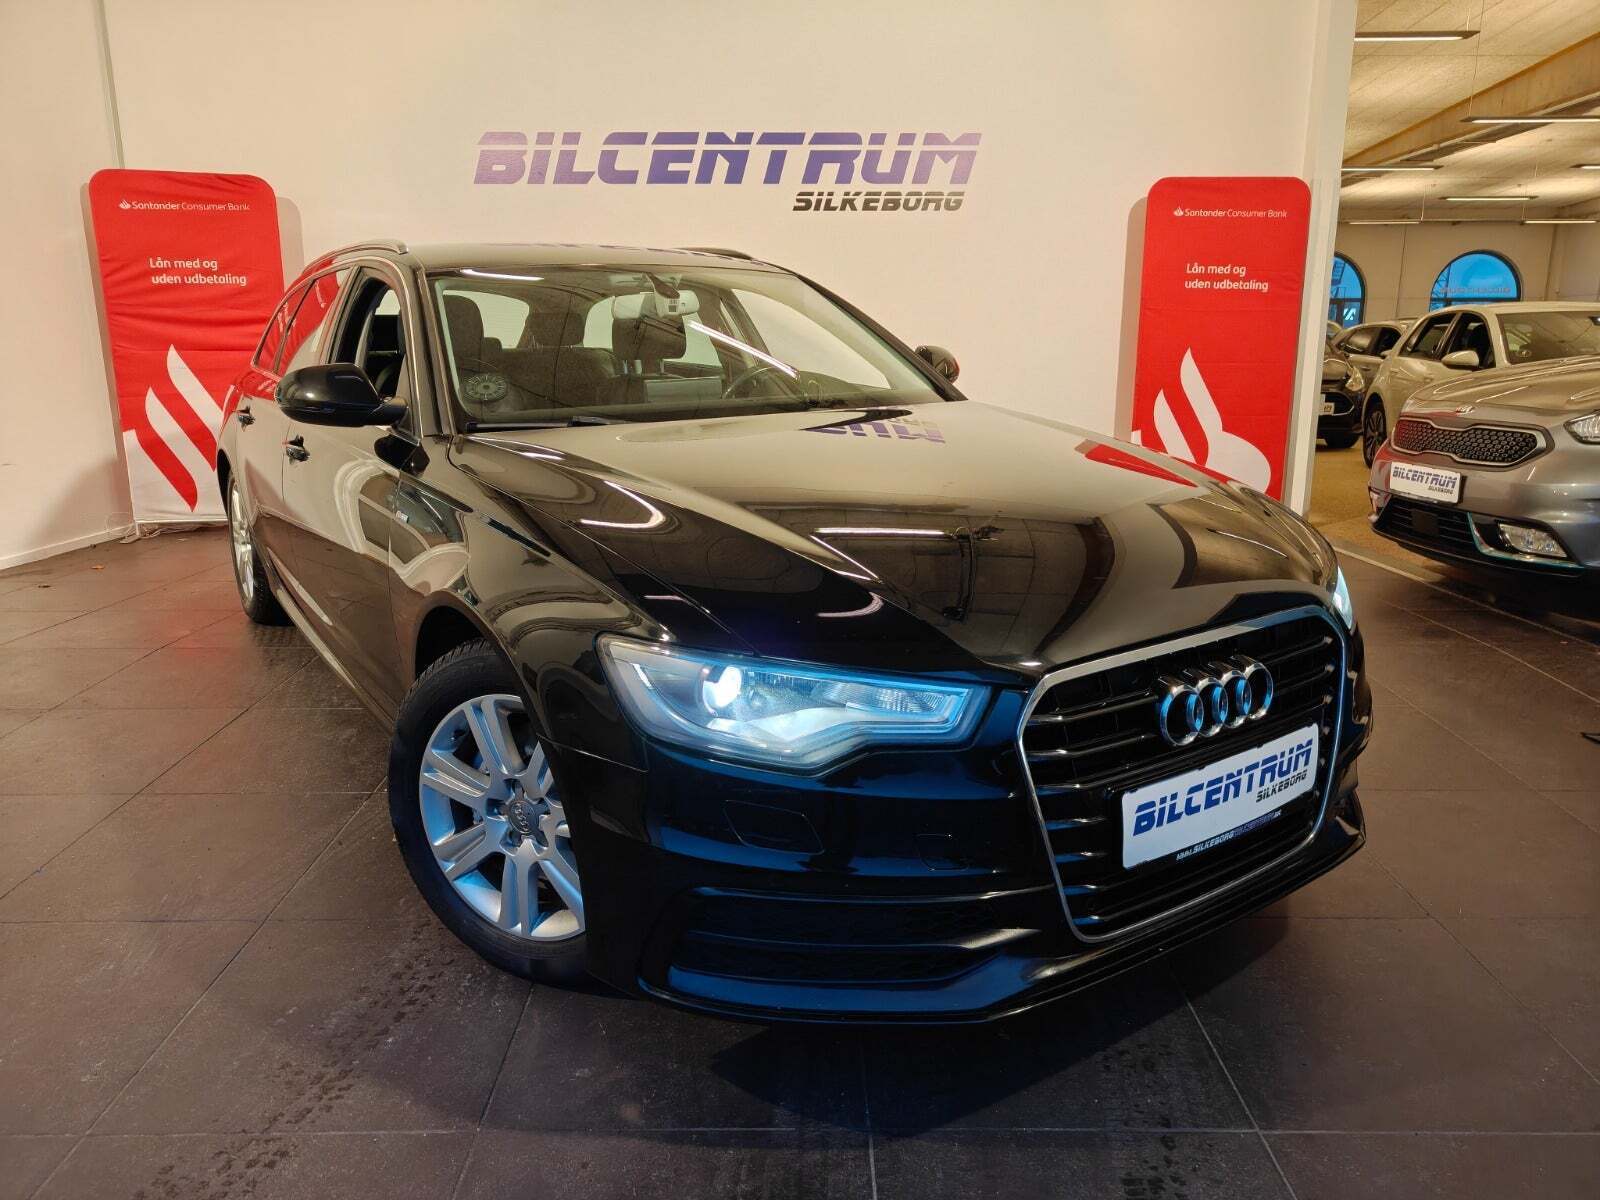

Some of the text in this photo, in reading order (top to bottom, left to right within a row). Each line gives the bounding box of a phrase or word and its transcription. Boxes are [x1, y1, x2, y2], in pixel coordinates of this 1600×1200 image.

[474, 131, 982, 184] BILCENTRUM
[131, 201, 250, 211] Santander Consumer Bank
[792, 191, 965, 211] SILKEBORG
[1184, 208, 1287, 218] Santander Consumer Bank
[149, 257, 218, 270] Lån med og
[1186, 262, 1246, 277] Lån med og
[152, 274, 247, 286] uden udbetaling
[1184, 279, 1269, 293] uden udbetaling
[1392, 466, 1458, 489] BILCENTRUM
[1133, 738, 1313, 837] BILCENTRUM
[1256, 769, 1308, 803] SILKEBORG
